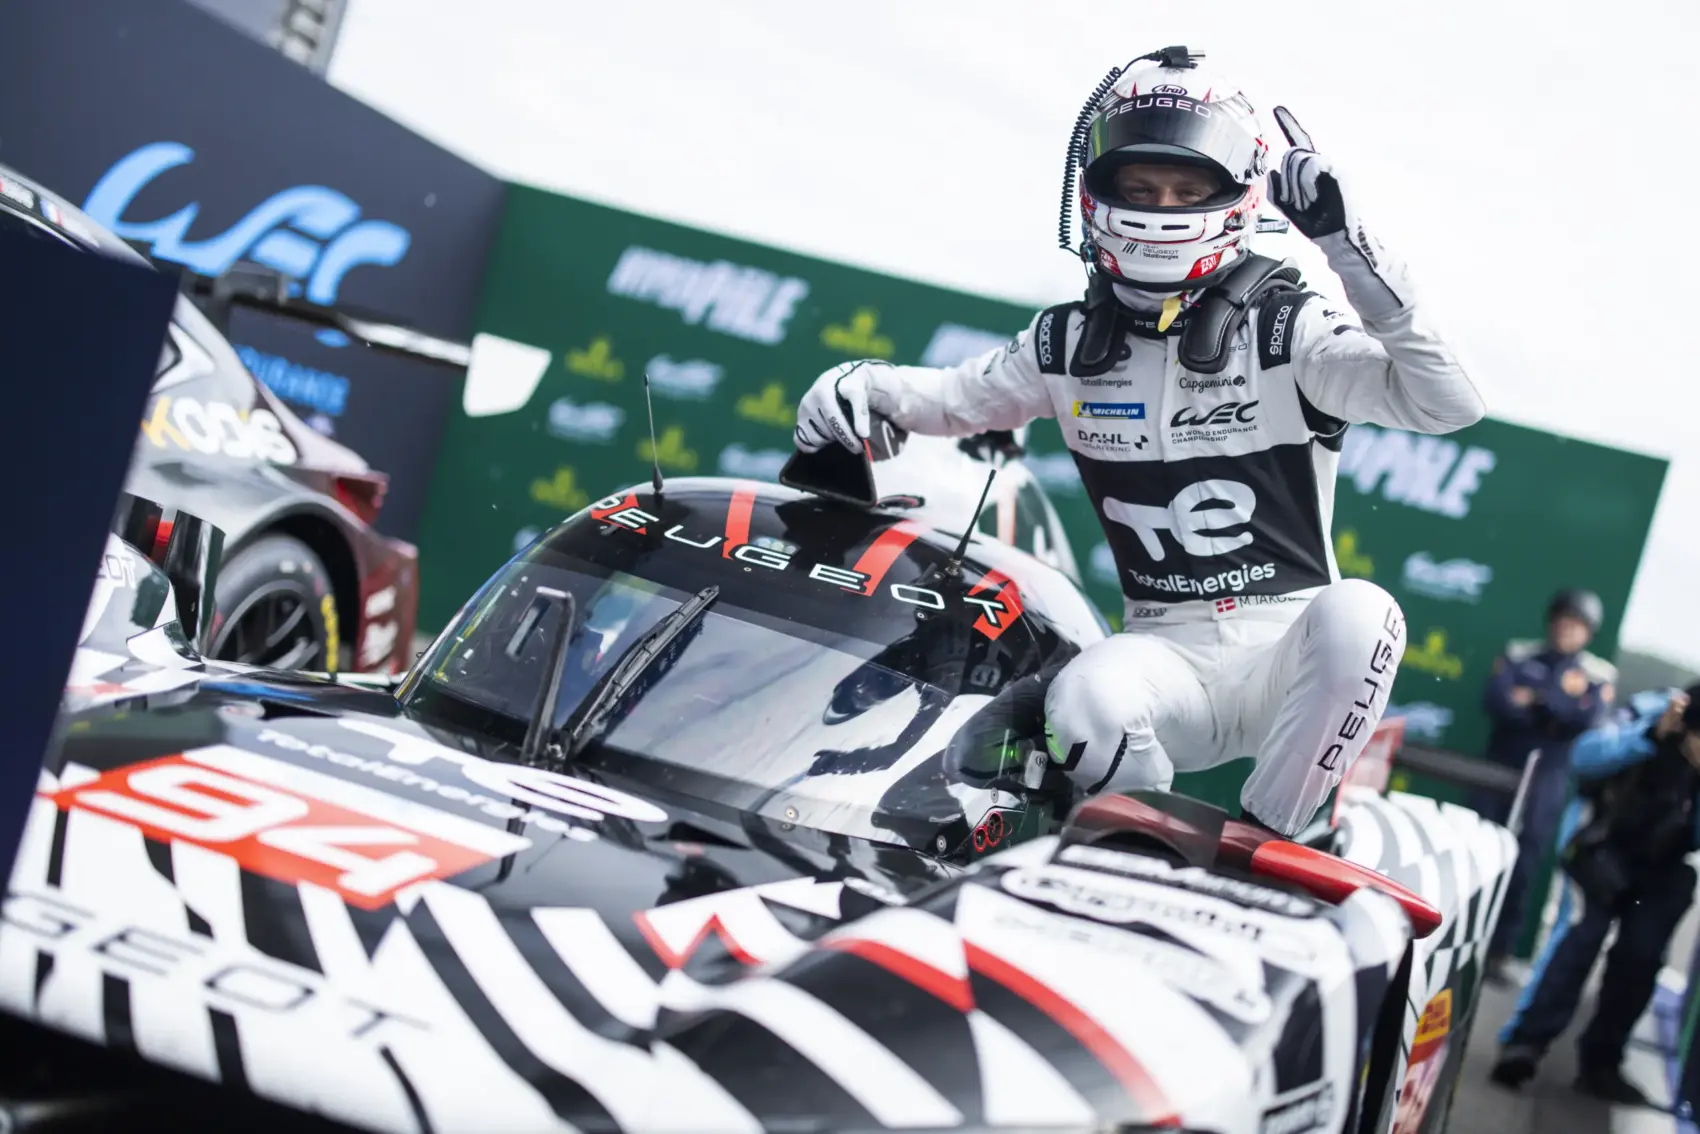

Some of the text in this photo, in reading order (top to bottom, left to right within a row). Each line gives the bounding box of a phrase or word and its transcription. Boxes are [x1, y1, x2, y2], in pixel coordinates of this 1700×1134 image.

[1160, 86, 1184, 95] Arai
[1105, 97, 1211, 123] PEUGEO
[1039, 313, 1055, 366] sparco
[1269, 305, 1293, 356] sparco
[1079, 378, 1133, 389] TotalEnergies
[1179, 377, 1233, 393] Capgemini
[1092, 408, 1140, 416] MICHELIN
[1170, 400, 1259, 428] WEC
[1077, 429, 1130, 445] DAHL
[1185, 429, 1211, 437] WORLD
[1212, 425, 1258, 436] ENDURANCE
[596, 494, 1006, 627] PEUGEOT
[1128, 562, 1276, 596] TotalEnergies
[1317, 606, 1401, 771] PEUGE
[75, 764, 438, 897] 94
